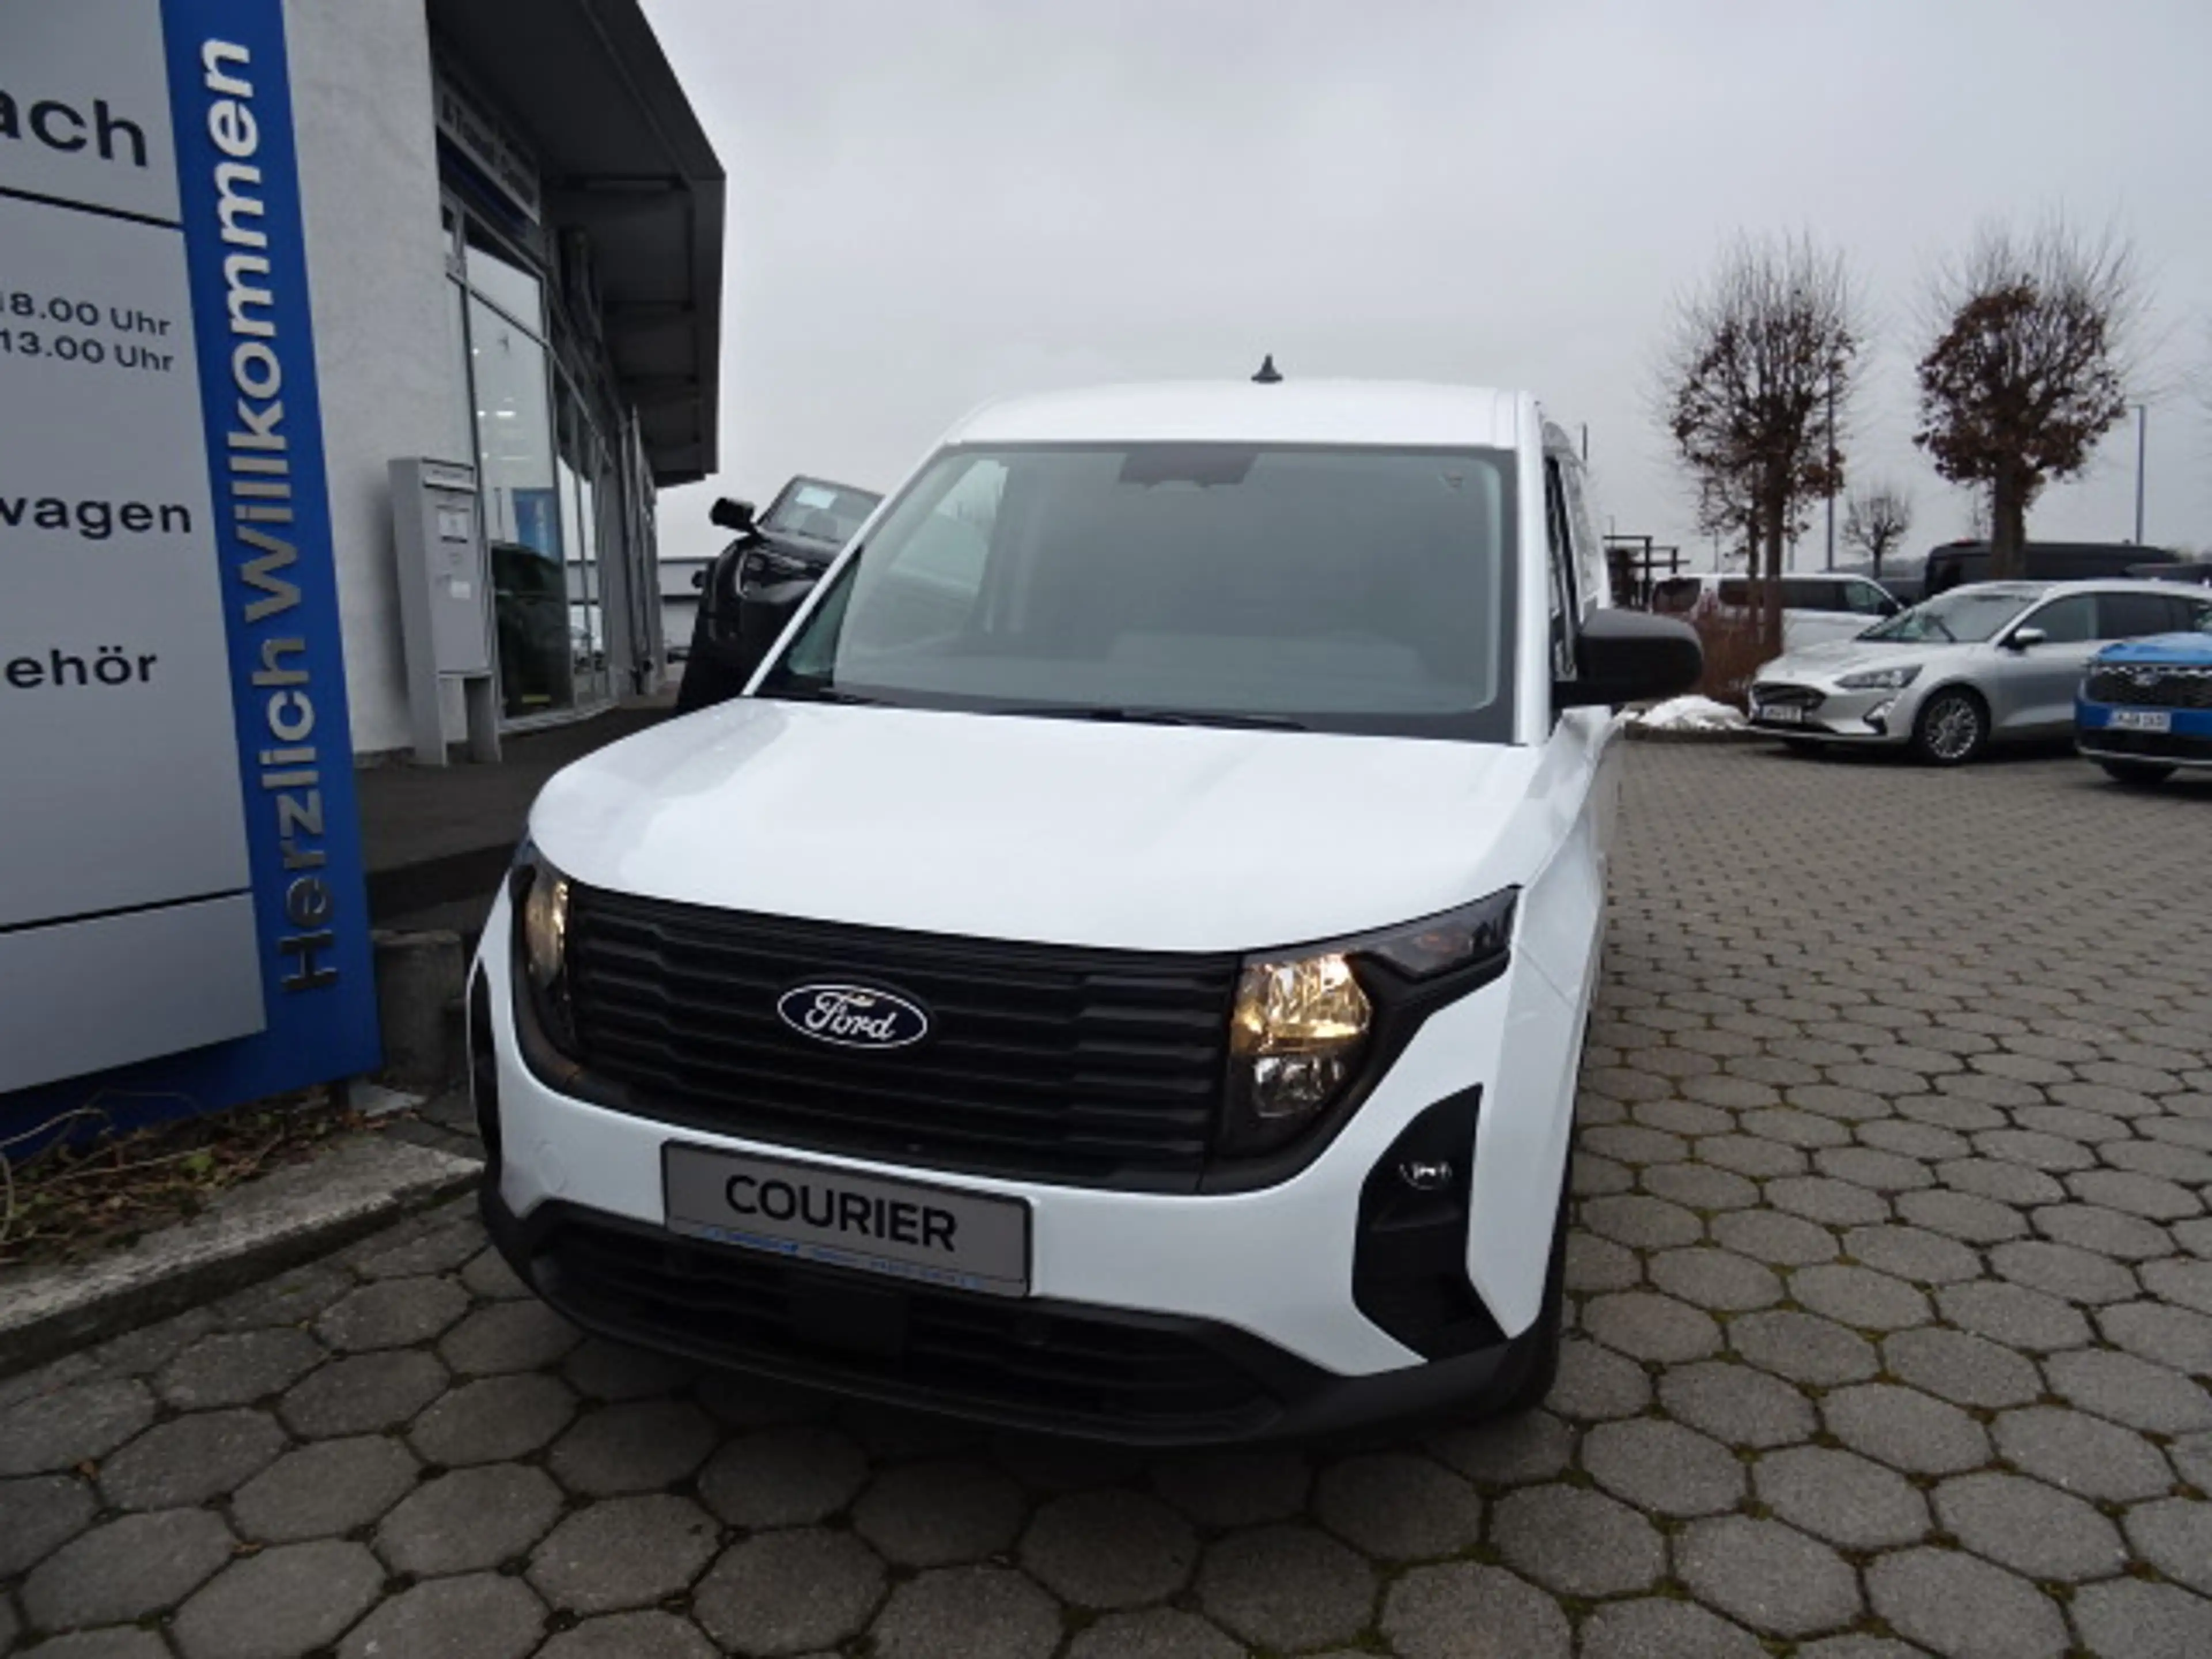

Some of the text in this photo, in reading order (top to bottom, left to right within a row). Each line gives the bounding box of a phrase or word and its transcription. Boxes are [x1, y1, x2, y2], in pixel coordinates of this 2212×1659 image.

[0, 291, 172, 335] 8.00 Uhr
[115, 344, 175, 372] Uhr
[200, 37, 338, 993] Herzlich Willkommen
[805, 991, 897, 1041] Ford
[725, 1174, 957, 1252] COURIER
